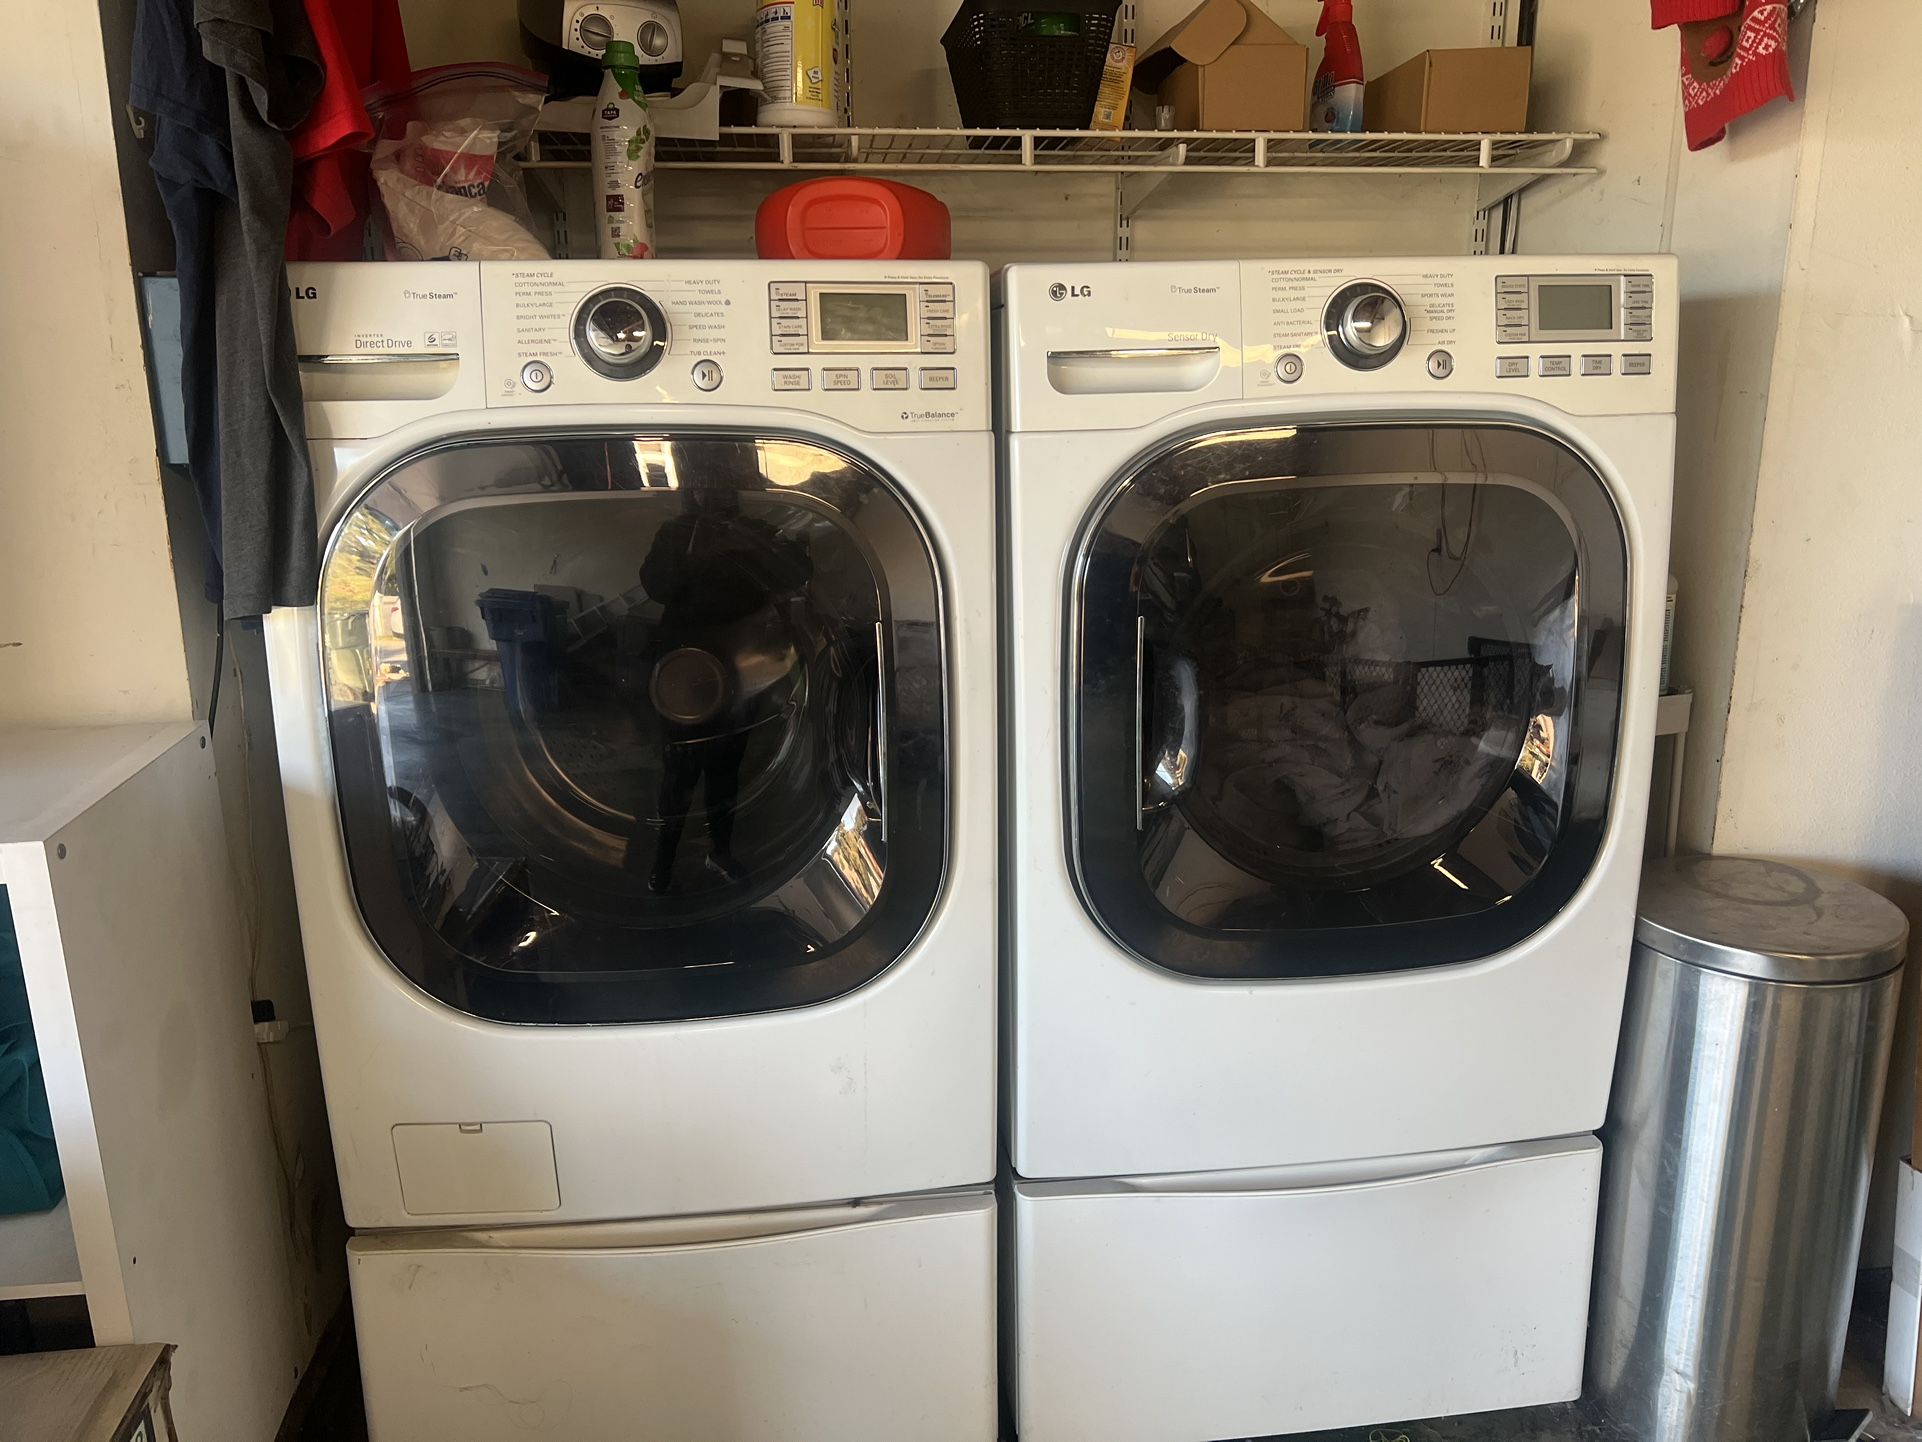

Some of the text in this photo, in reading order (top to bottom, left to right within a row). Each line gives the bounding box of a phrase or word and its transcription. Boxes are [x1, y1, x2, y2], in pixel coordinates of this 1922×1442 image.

[295, 286, 317, 300] LG
[1070, 285, 1092, 298] LG
[1167, 330, 1219, 343] Sensor Dry
[355, 338, 412, 349] Direct Drive
